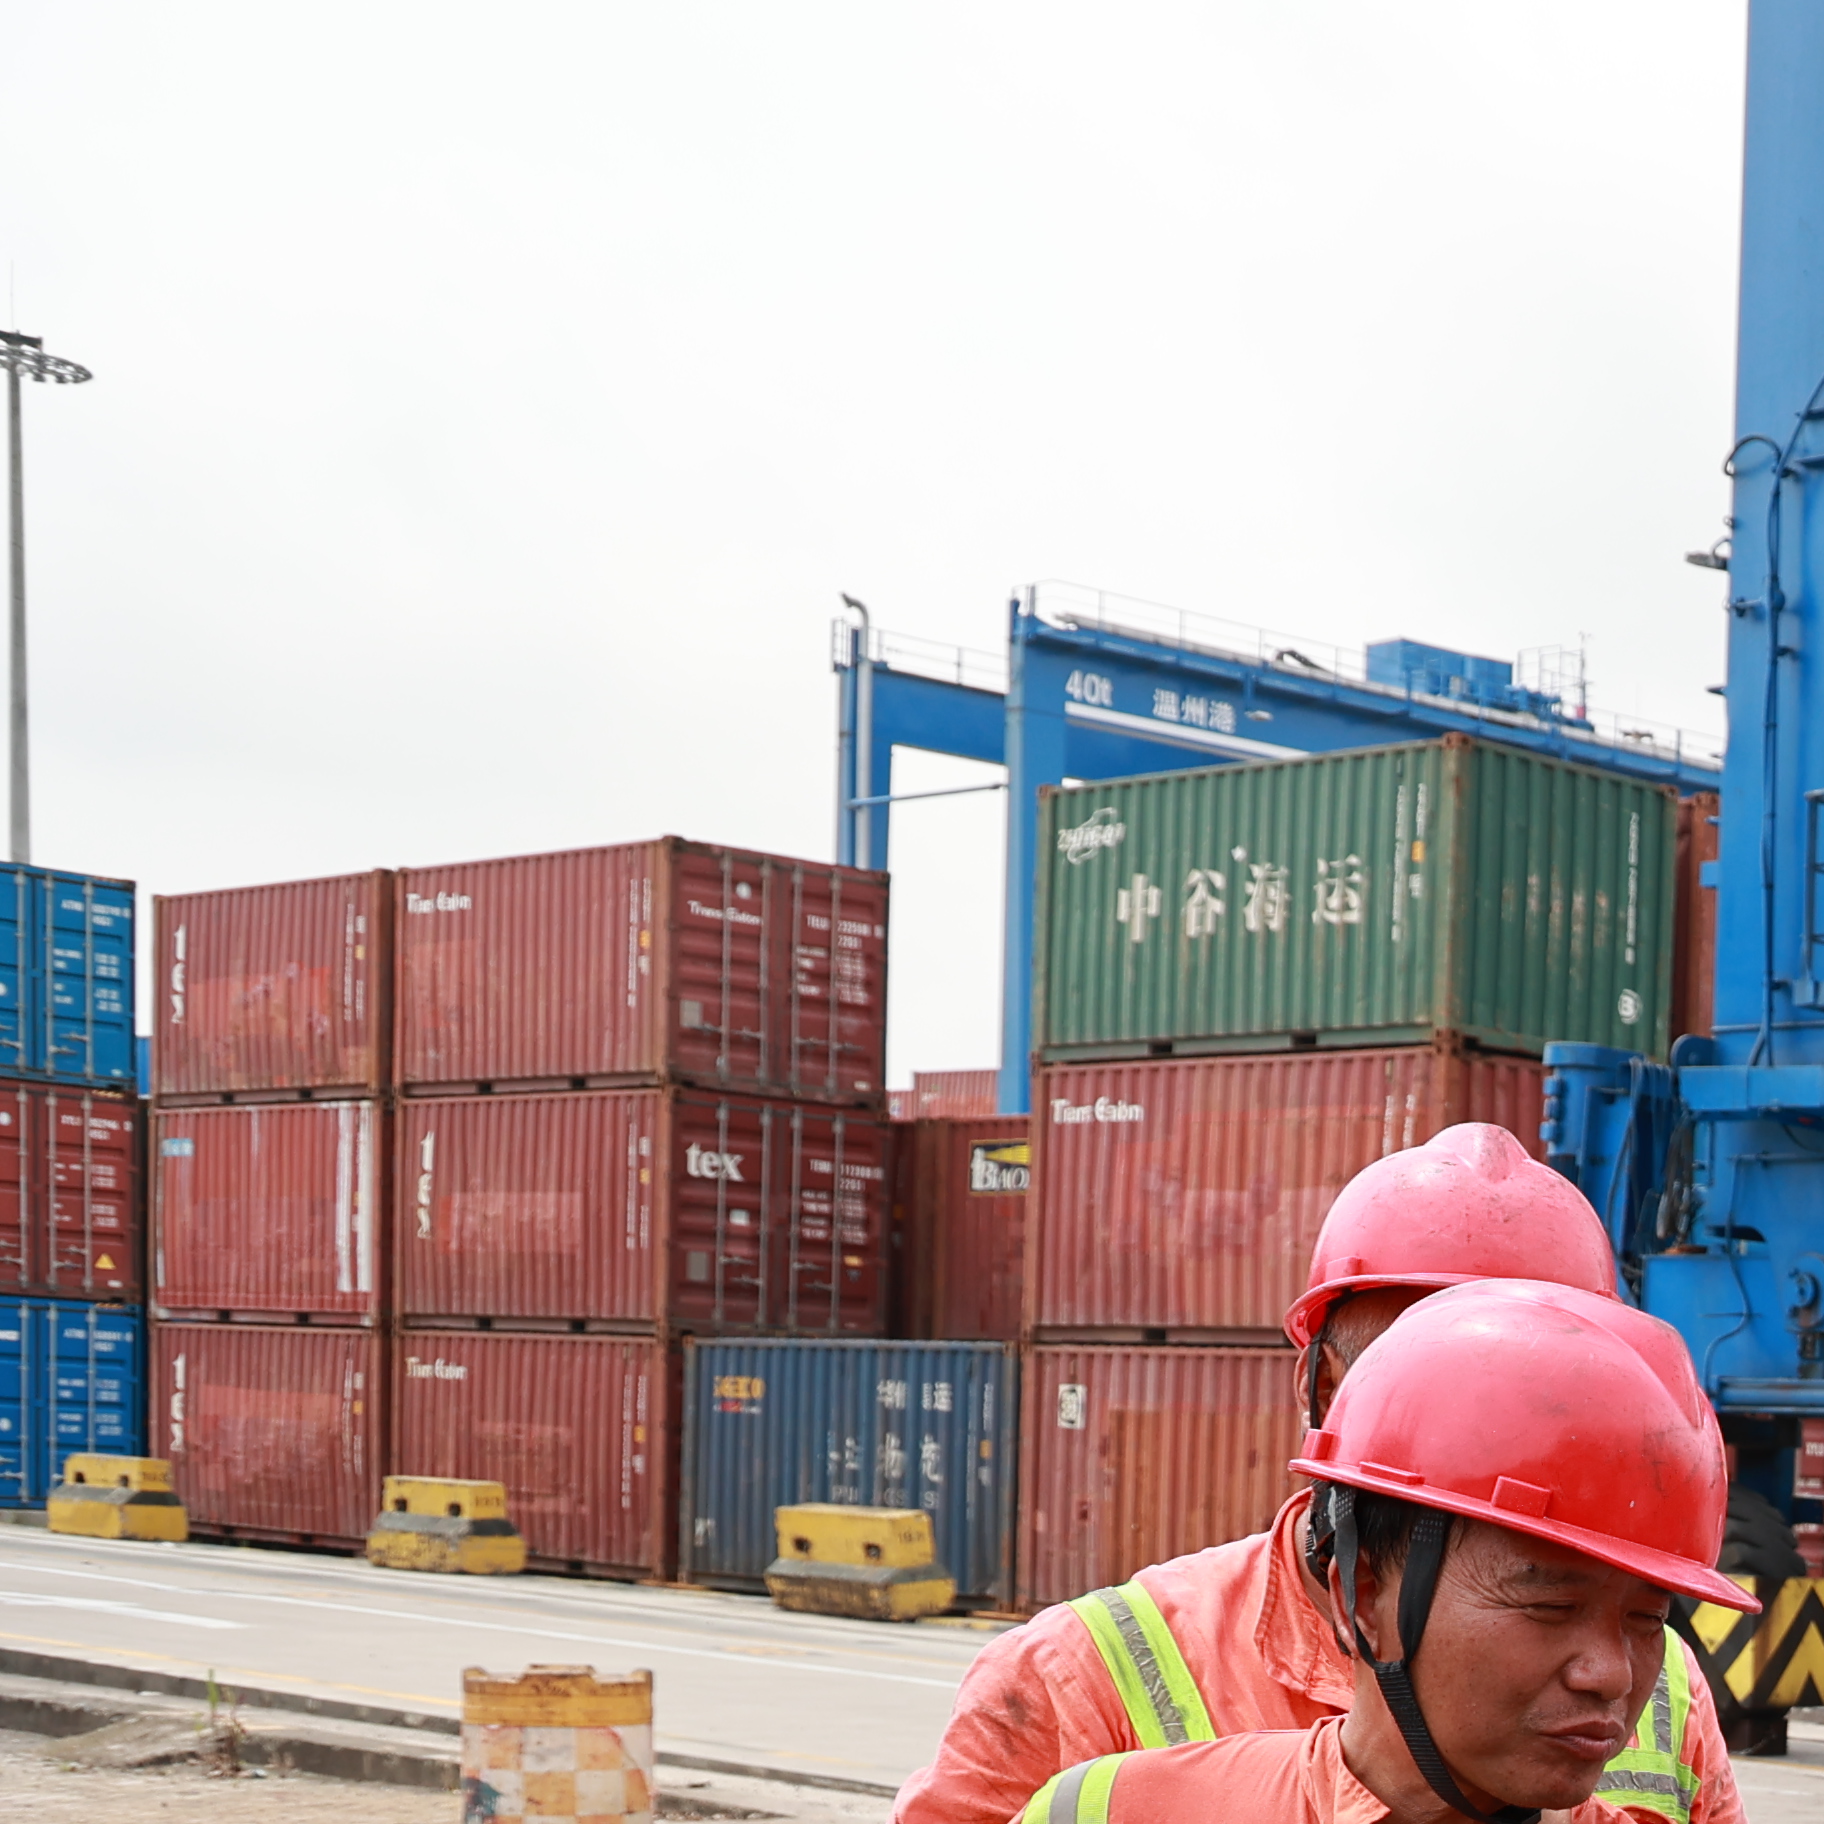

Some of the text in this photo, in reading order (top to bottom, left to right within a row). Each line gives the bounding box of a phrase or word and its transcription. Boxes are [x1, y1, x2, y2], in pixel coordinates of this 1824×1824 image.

[1065, 670, 1113, 707] 40t
[1153, 688, 1237, 735] 温州港
[1116, 853, 1363, 943] 中谷海运
[685, 1142, 745, 1182] tex
